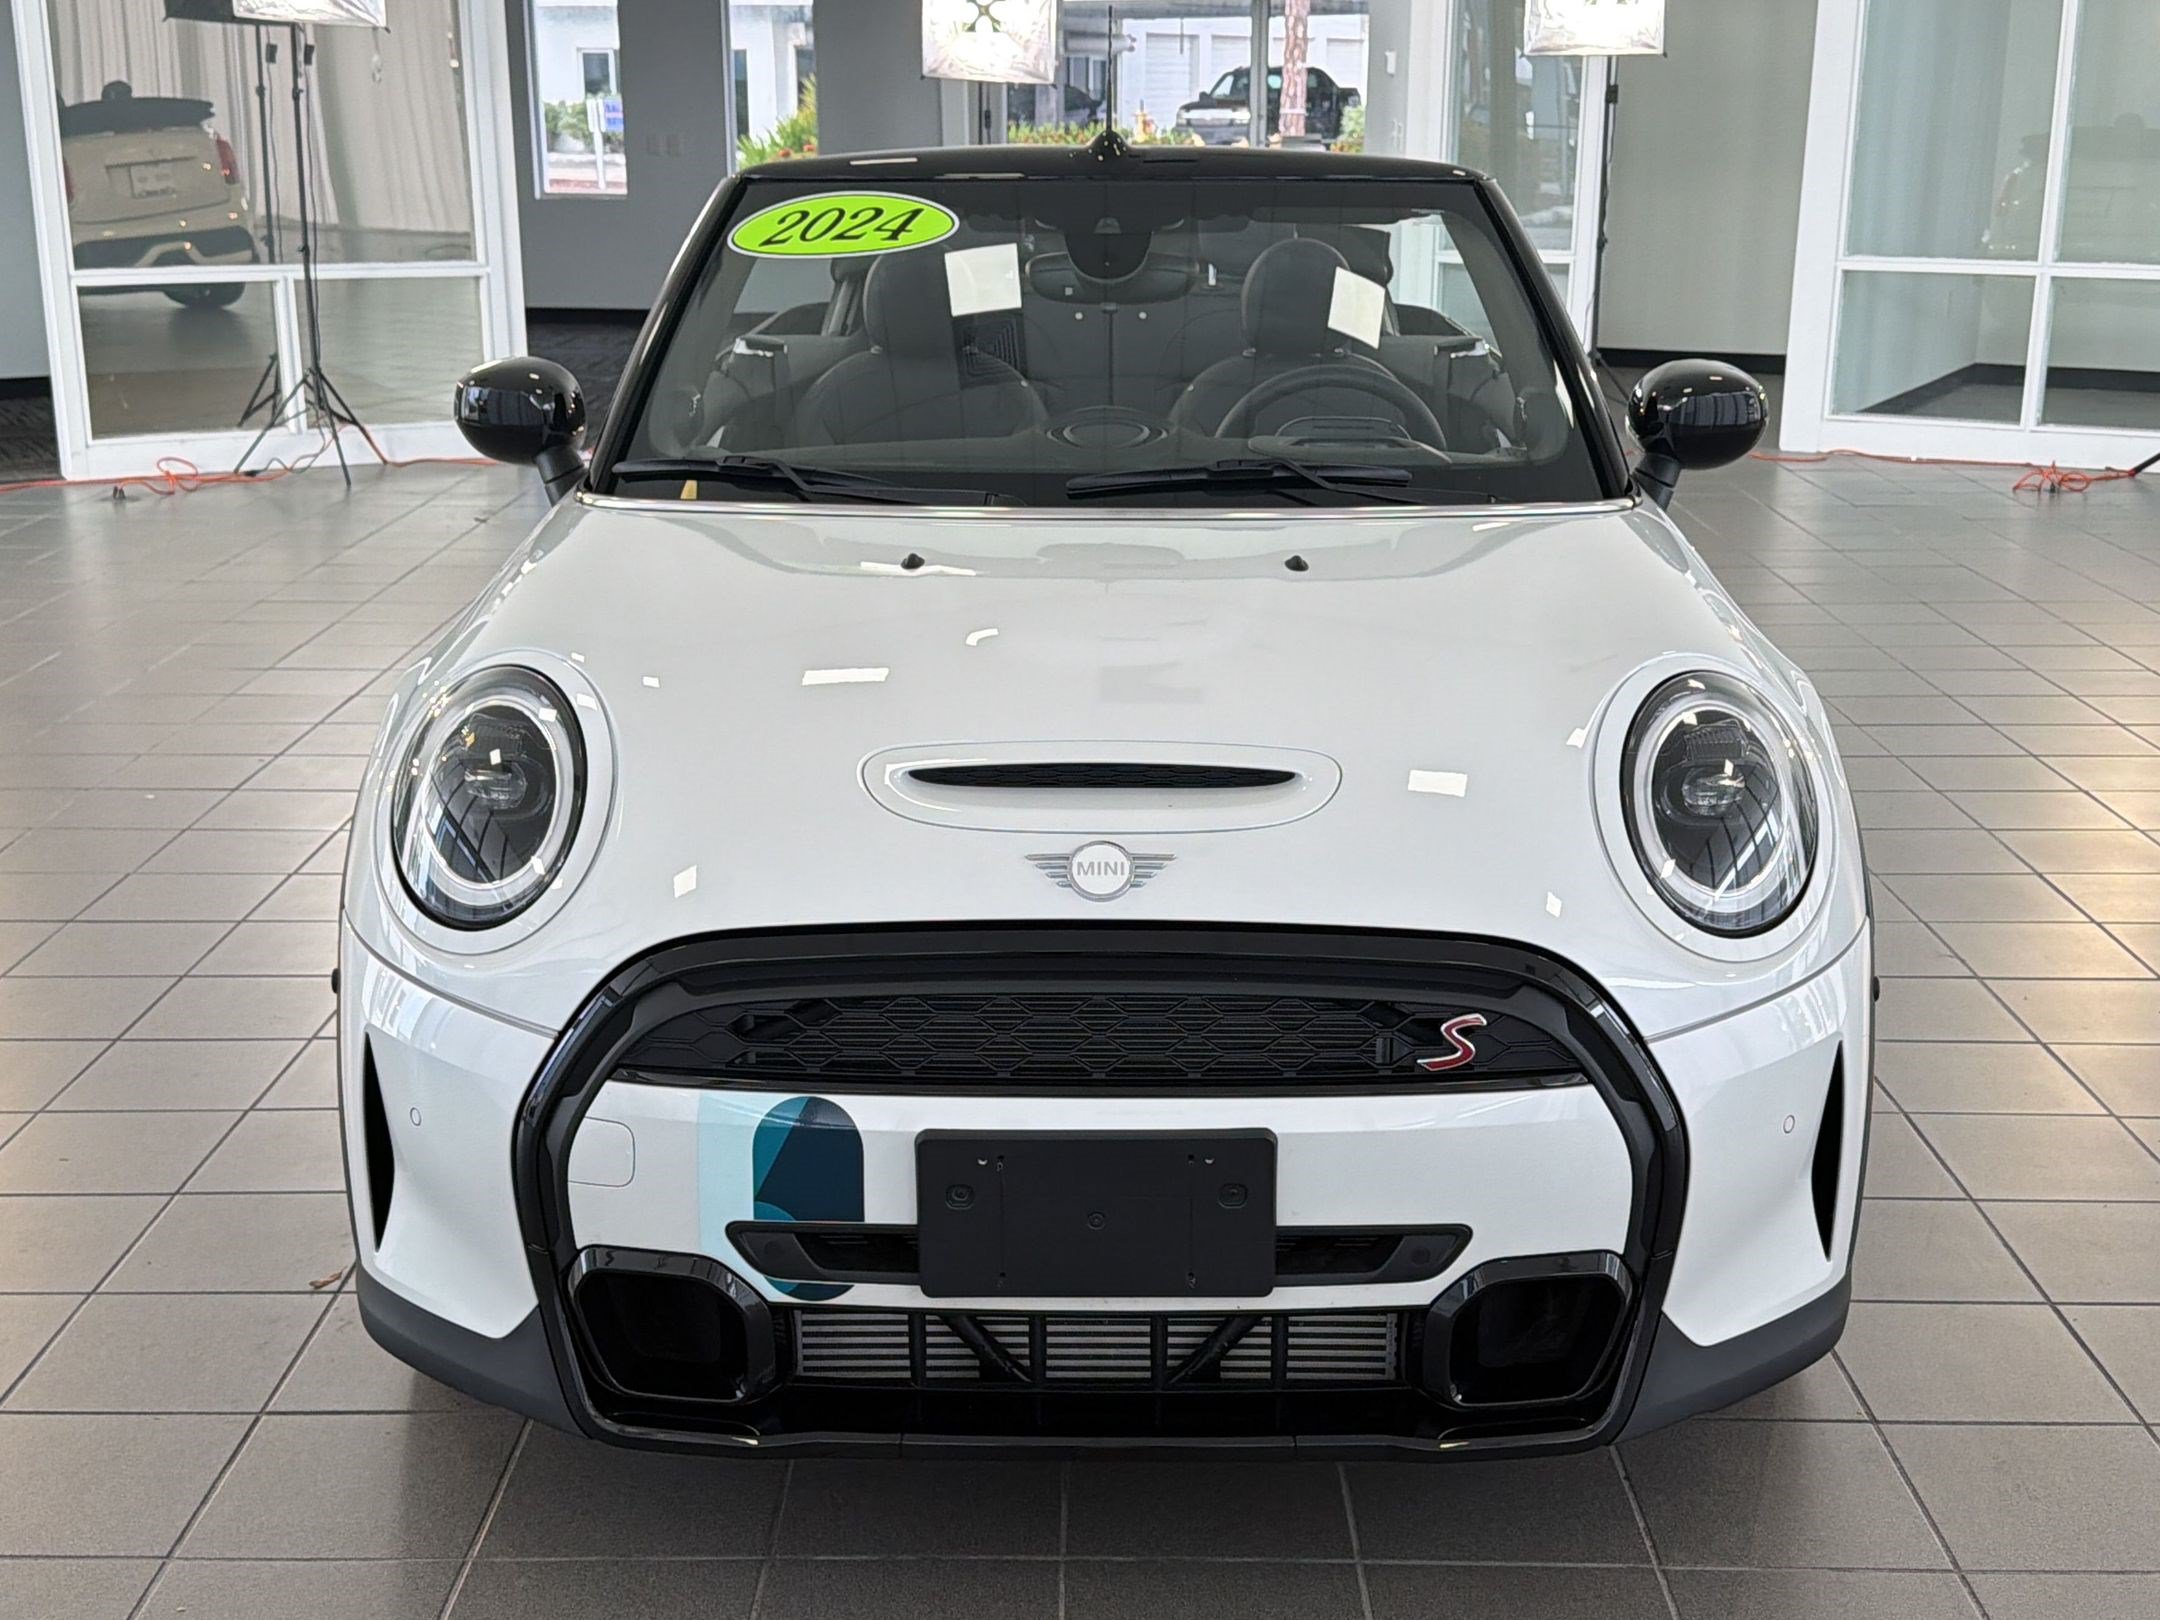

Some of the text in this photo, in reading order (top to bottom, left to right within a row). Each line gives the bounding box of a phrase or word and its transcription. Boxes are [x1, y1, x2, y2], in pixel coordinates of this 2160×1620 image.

[758, 207, 925, 247] 2024
[1076, 861, 1125, 876] MINI
[1416, 1013, 1487, 1071] S
